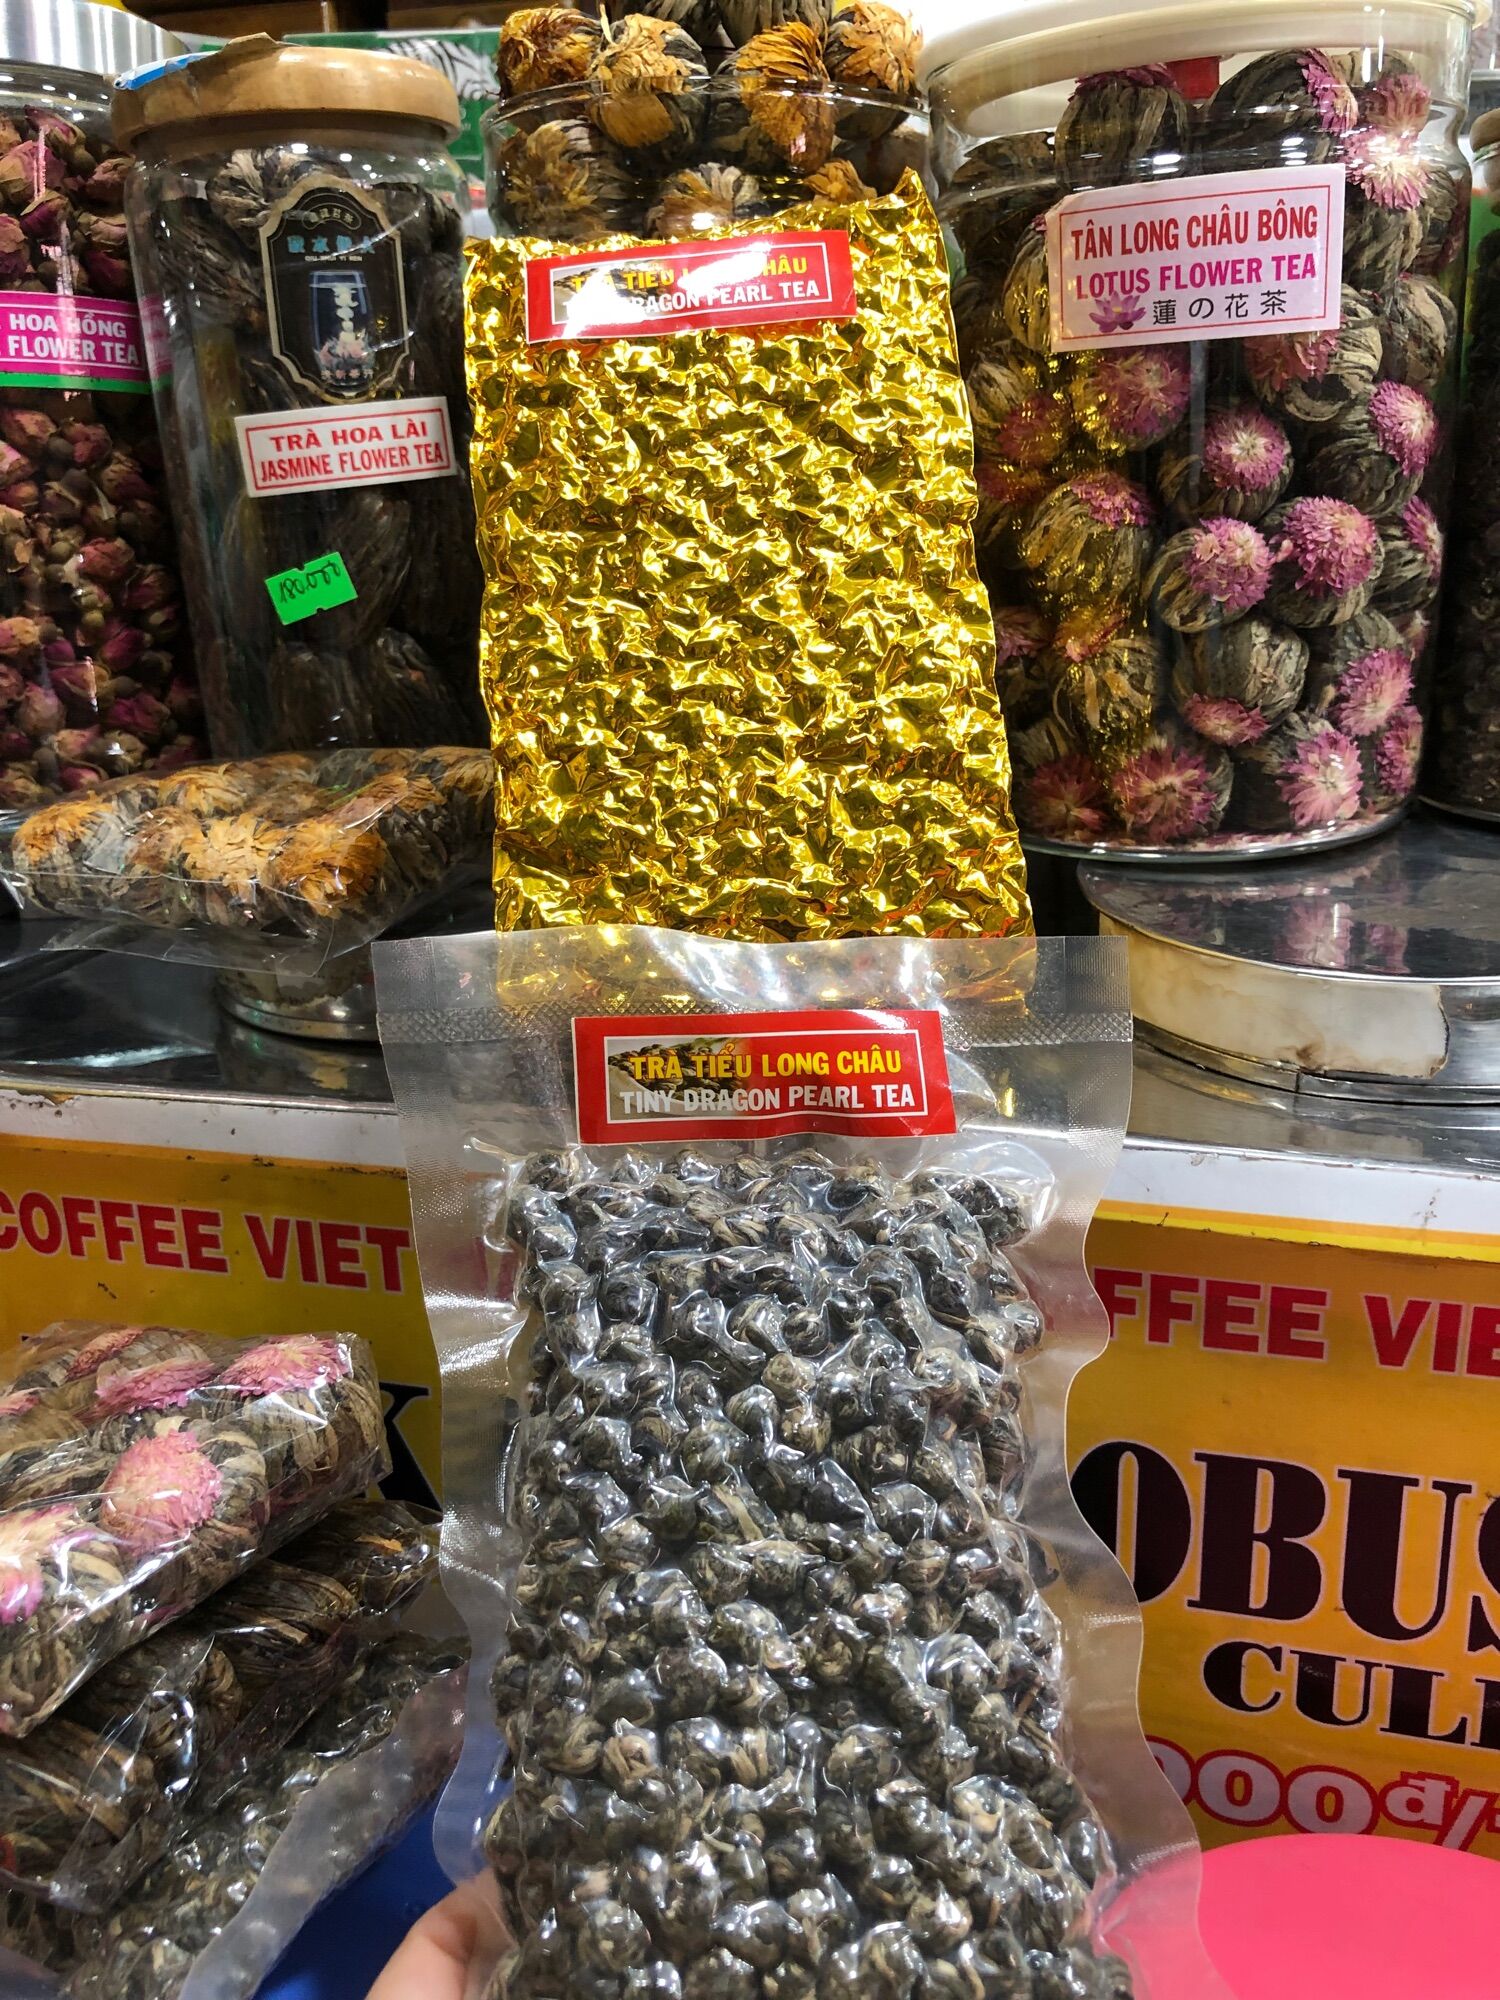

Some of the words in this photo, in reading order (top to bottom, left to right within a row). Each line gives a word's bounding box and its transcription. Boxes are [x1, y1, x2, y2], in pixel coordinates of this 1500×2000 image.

[1071, 219, 1113, 261] TÂN
[1121, 218, 1179, 256] LONG
[1186, 203, 1249, 249] CHÂU
[1257, 198, 1318, 242] BÔNG
[757, 254, 808, 278] HÂU
[1076, 267, 1150, 300] LOTUS
[1159, 257, 1262, 292] FLOWER
[1271, 252, 1316, 282] TEA
[618, 290, 701, 314] RAGON
[706, 284, 773, 306] PEARL
[778, 279, 820, 299] TEA
[1152, 290, 1287, 326] 蓮の花茶
[9, 312, 59, 333] HOA
[8, 334, 97, 362] FLOWER
[101, 341, 139, 366] TEA
[270, 428, 322, 453] TRÀ
[331, 426, 383, 446] HOA
[391, 418, 428, 440] LÀI
[260, 453, 334, 483] JASMINE
[339, 444, 410, 474] FLOWER
[413, 442, 444, 465] TEA
[629, 1048, 683, 1080] TRÀ
[696, 1042, 752, 1079] TIỂU
[762, 1051, 830, 1078] LONG
[837, 1044, 902, 1075] CHÂU
[619, 1089, 679, 1115] TINY
[684, 1087, 780, 1113] DRAGON
[789, 1083, 866, 1110] PEARL
[871, 1083, 916, 1109] TEA
[243, 1213, 412, 1295] VIET
[1070, 1440, 1500, 1654] OBU
